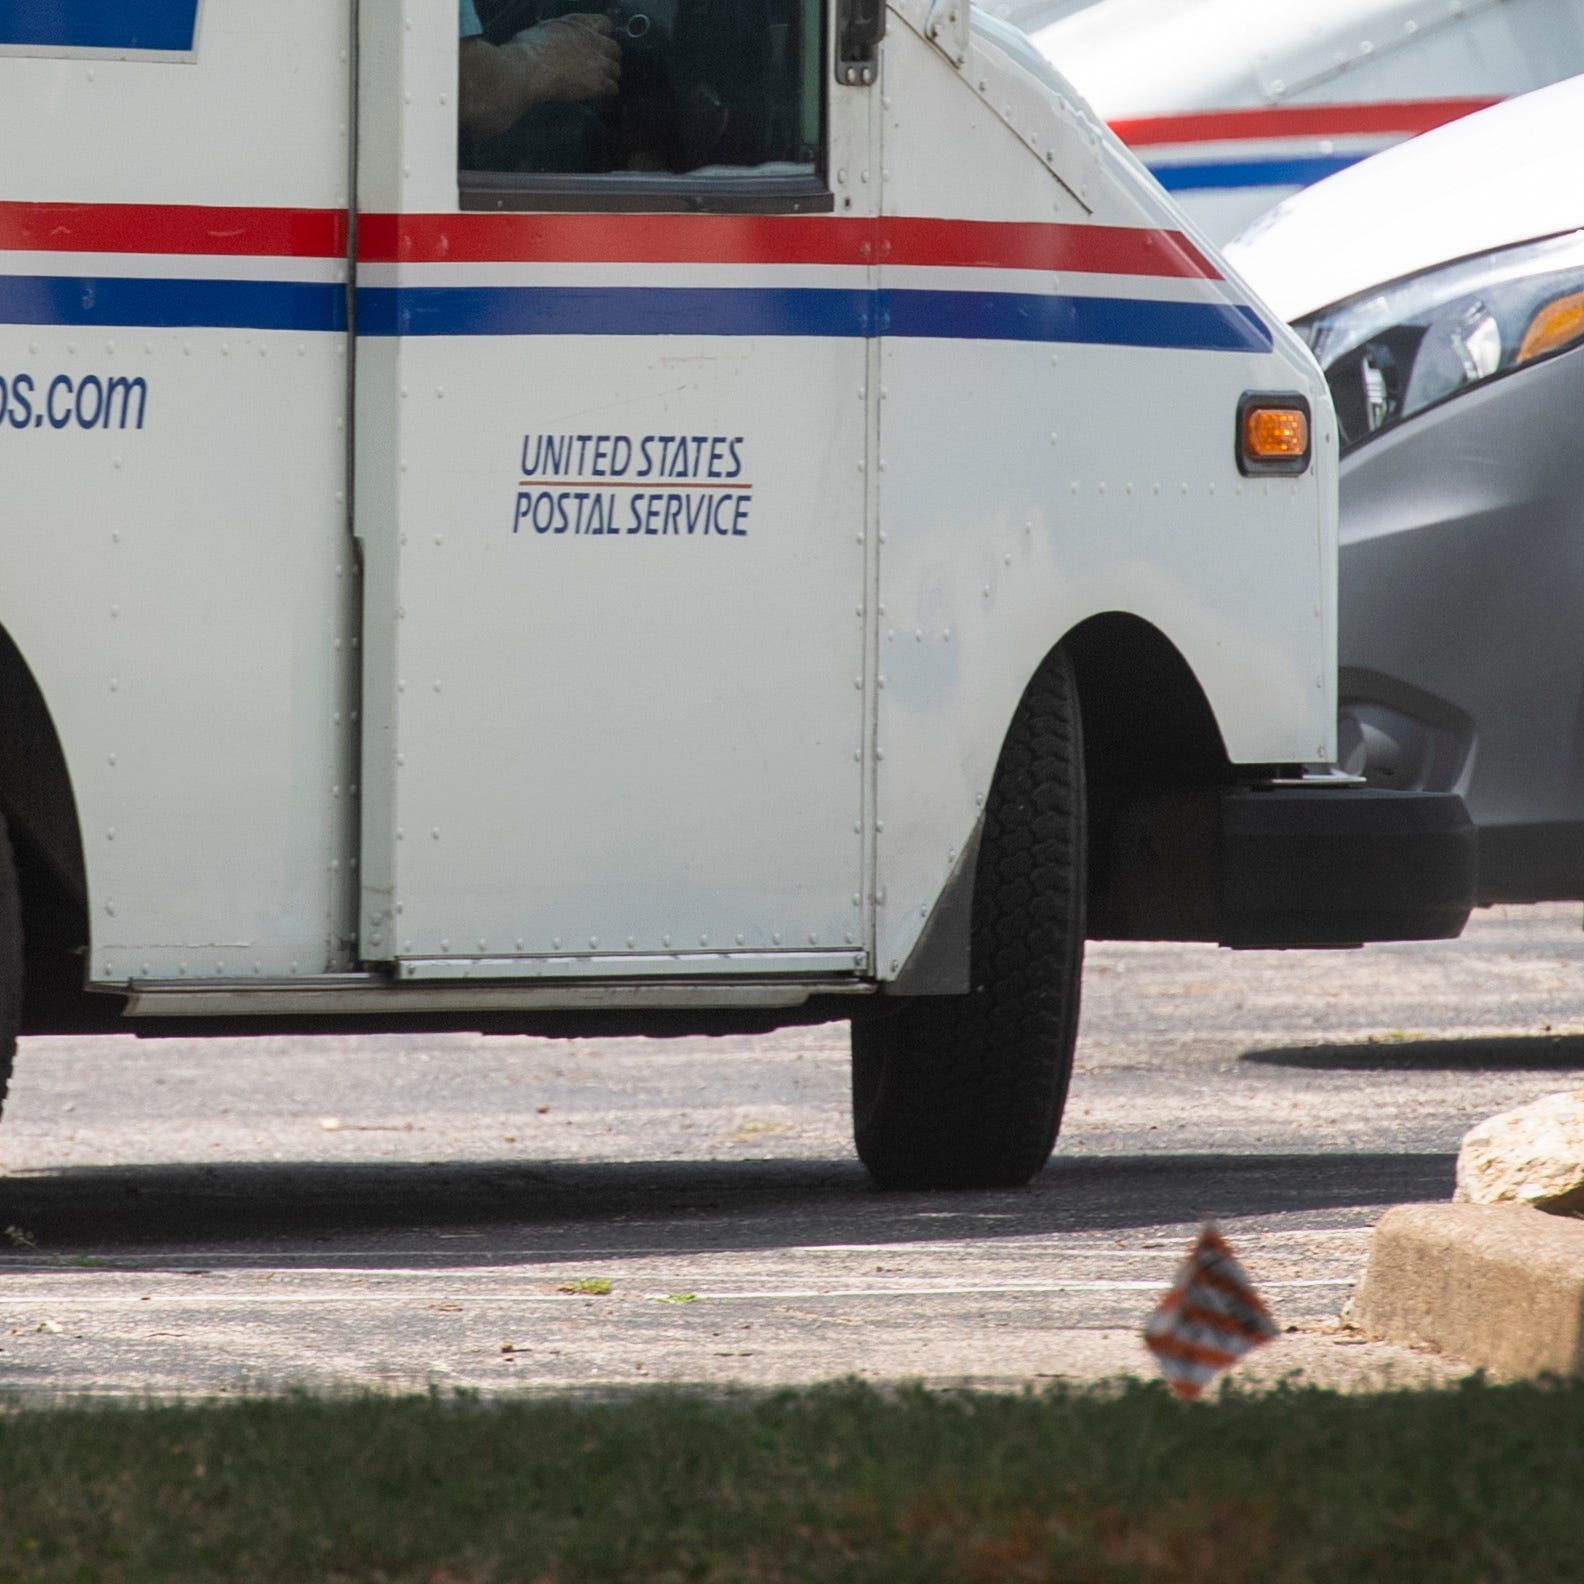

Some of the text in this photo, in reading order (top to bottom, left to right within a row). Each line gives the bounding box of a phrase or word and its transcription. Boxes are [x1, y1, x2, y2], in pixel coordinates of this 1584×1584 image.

[520, 434, 745, 478] UNITED STATES
[512, 491, 753, 537] POSTAL SERVICE
